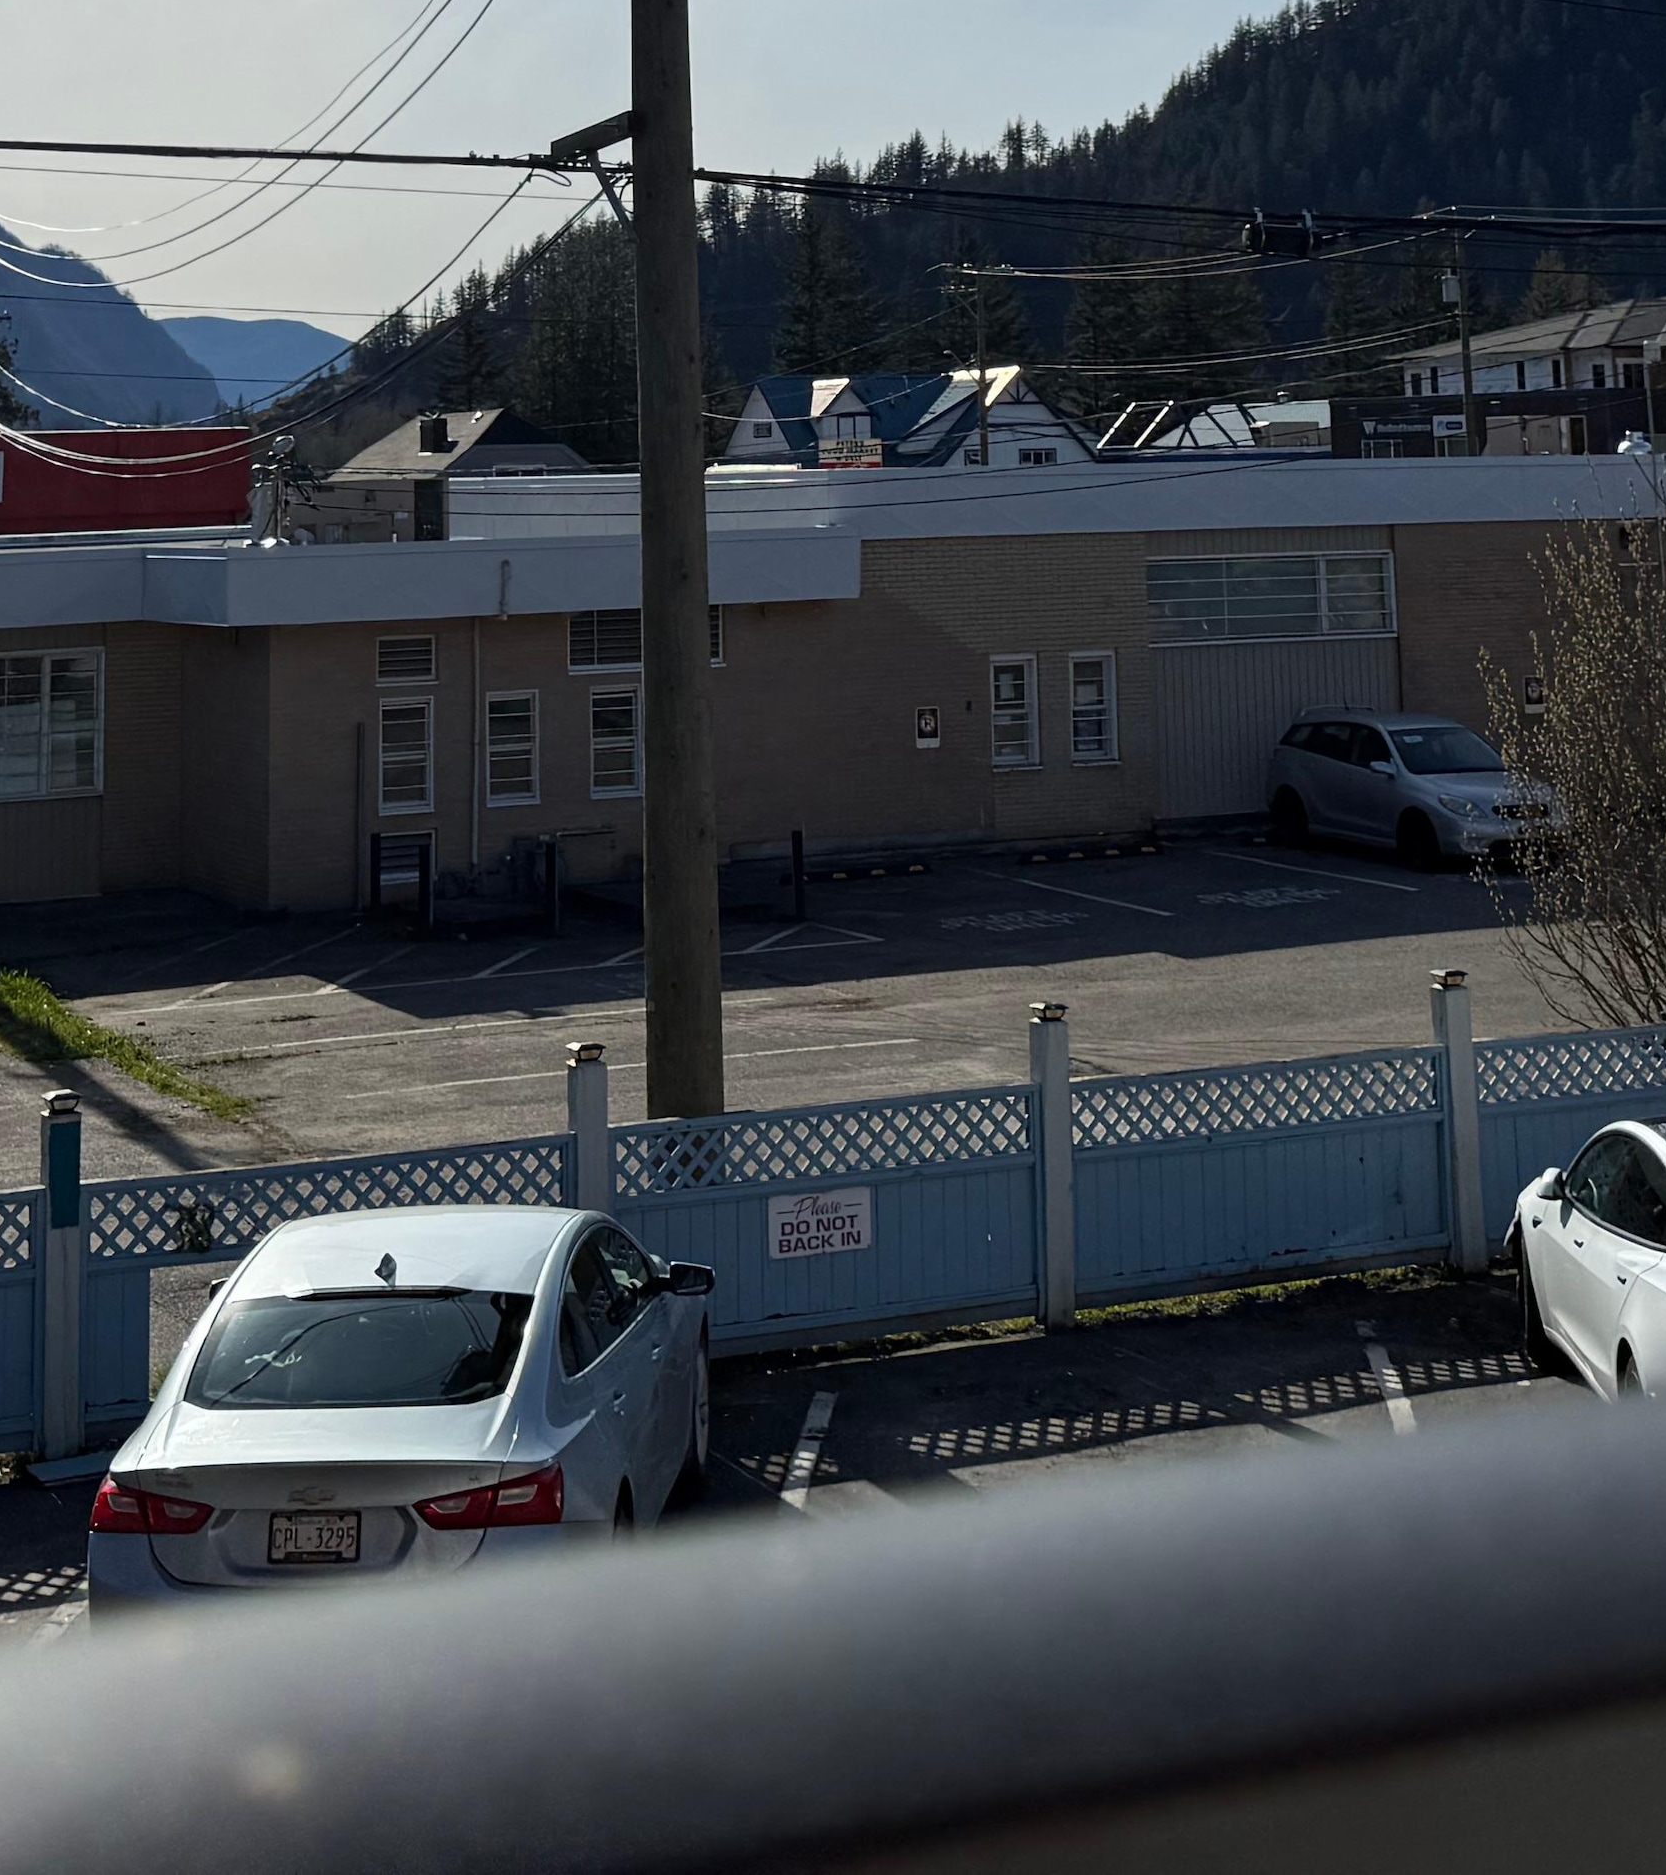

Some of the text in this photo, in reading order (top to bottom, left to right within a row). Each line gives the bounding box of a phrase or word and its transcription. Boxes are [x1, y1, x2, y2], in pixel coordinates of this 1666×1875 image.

[793, 1196, 842, 1220] Please
[781, 1215, 858, 1236] DO NOT
[779, 1231, 861, 1253] BACK IN
